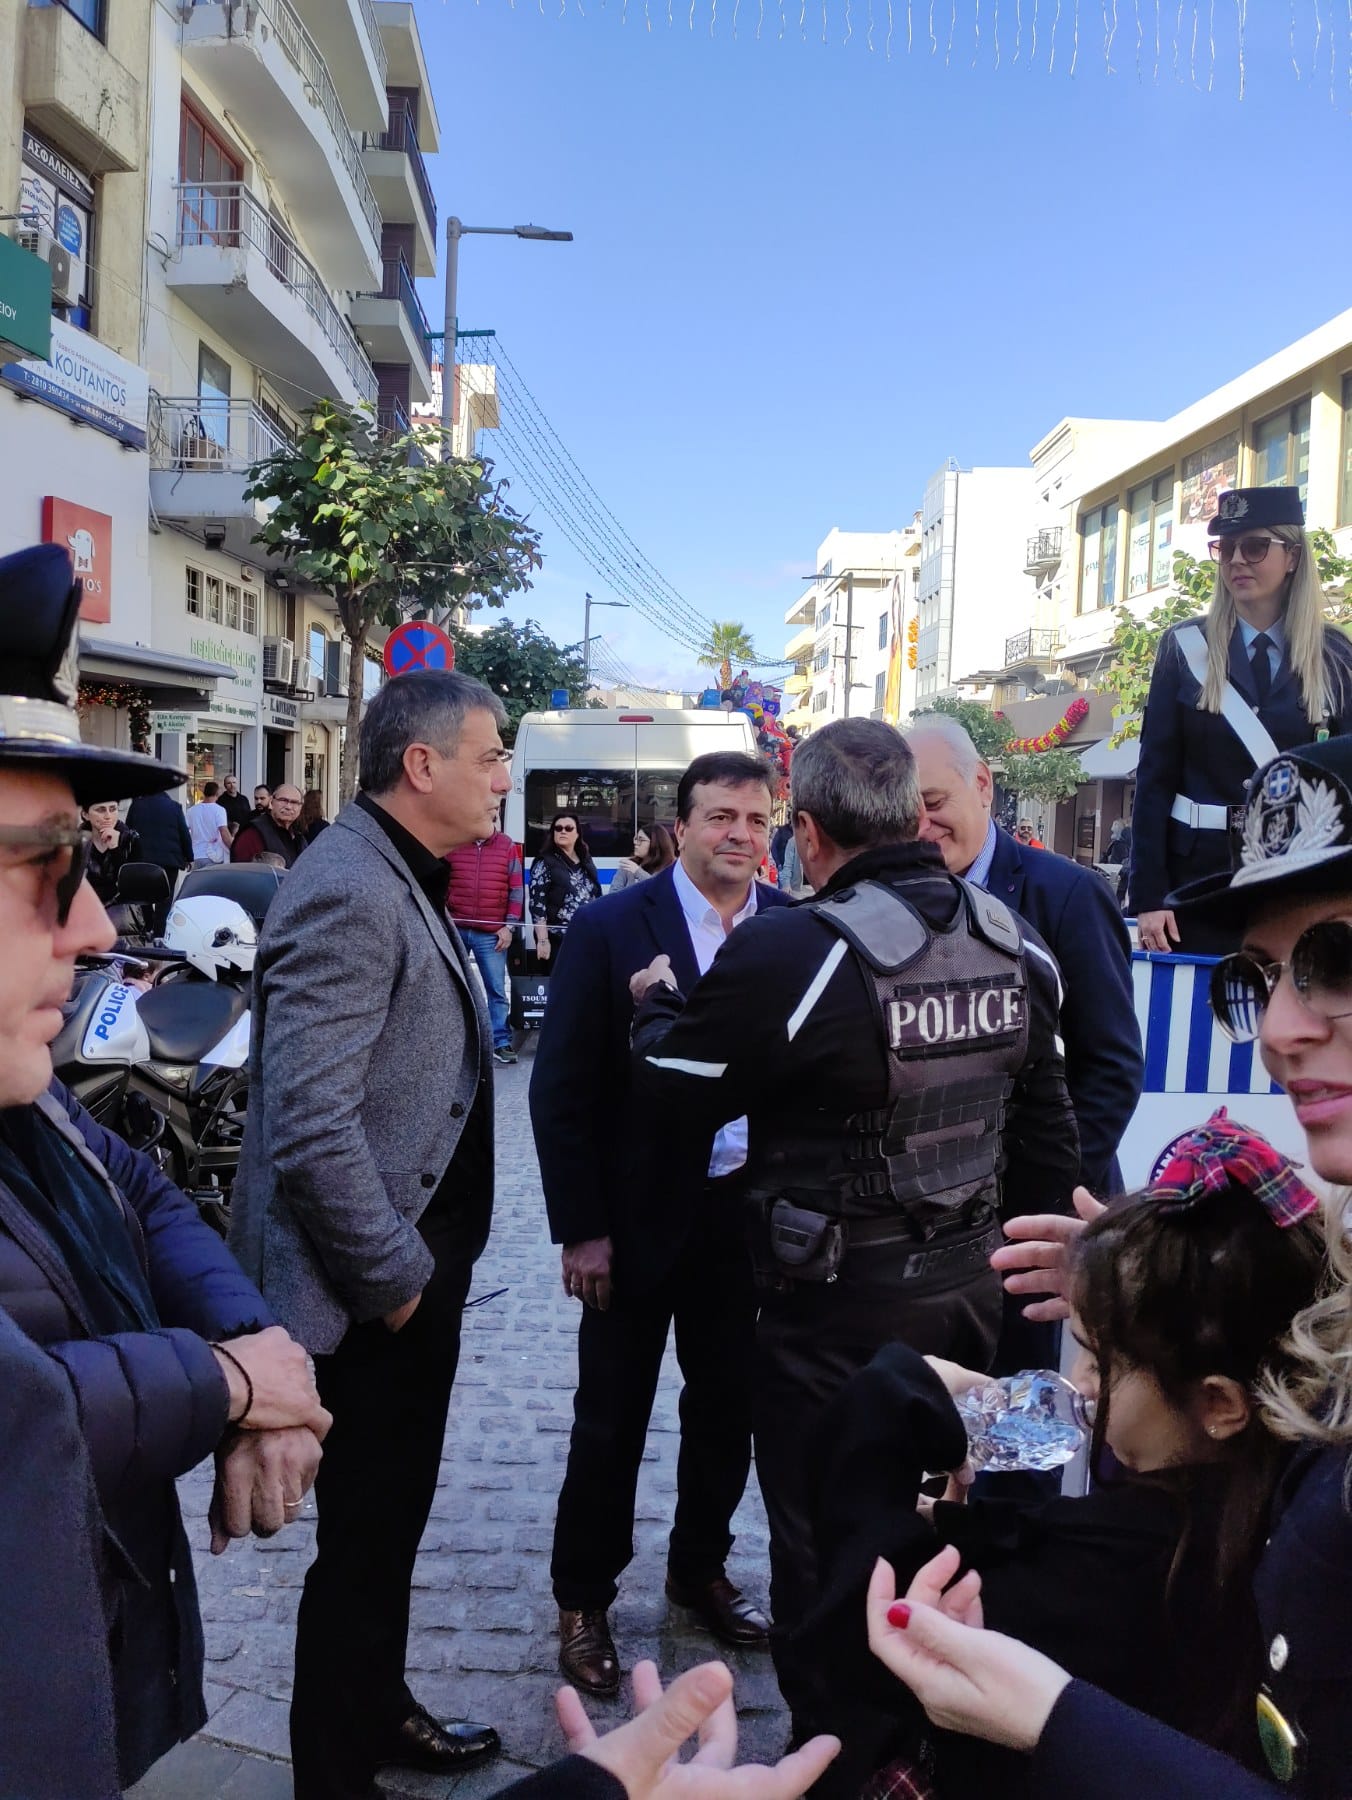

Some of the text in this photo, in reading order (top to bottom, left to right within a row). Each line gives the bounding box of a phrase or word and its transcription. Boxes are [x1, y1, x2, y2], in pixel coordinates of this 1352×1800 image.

[26, 138, 81, 190] ΑΣΦΑΛΕΙΕΣ
[31, 375, 47, 391] 2810
[55, 351, 127, 407] KOUTANTOS
[94, 985, 129, 1041] POLICE
[890, 988, 1024, 1049] POLICE
